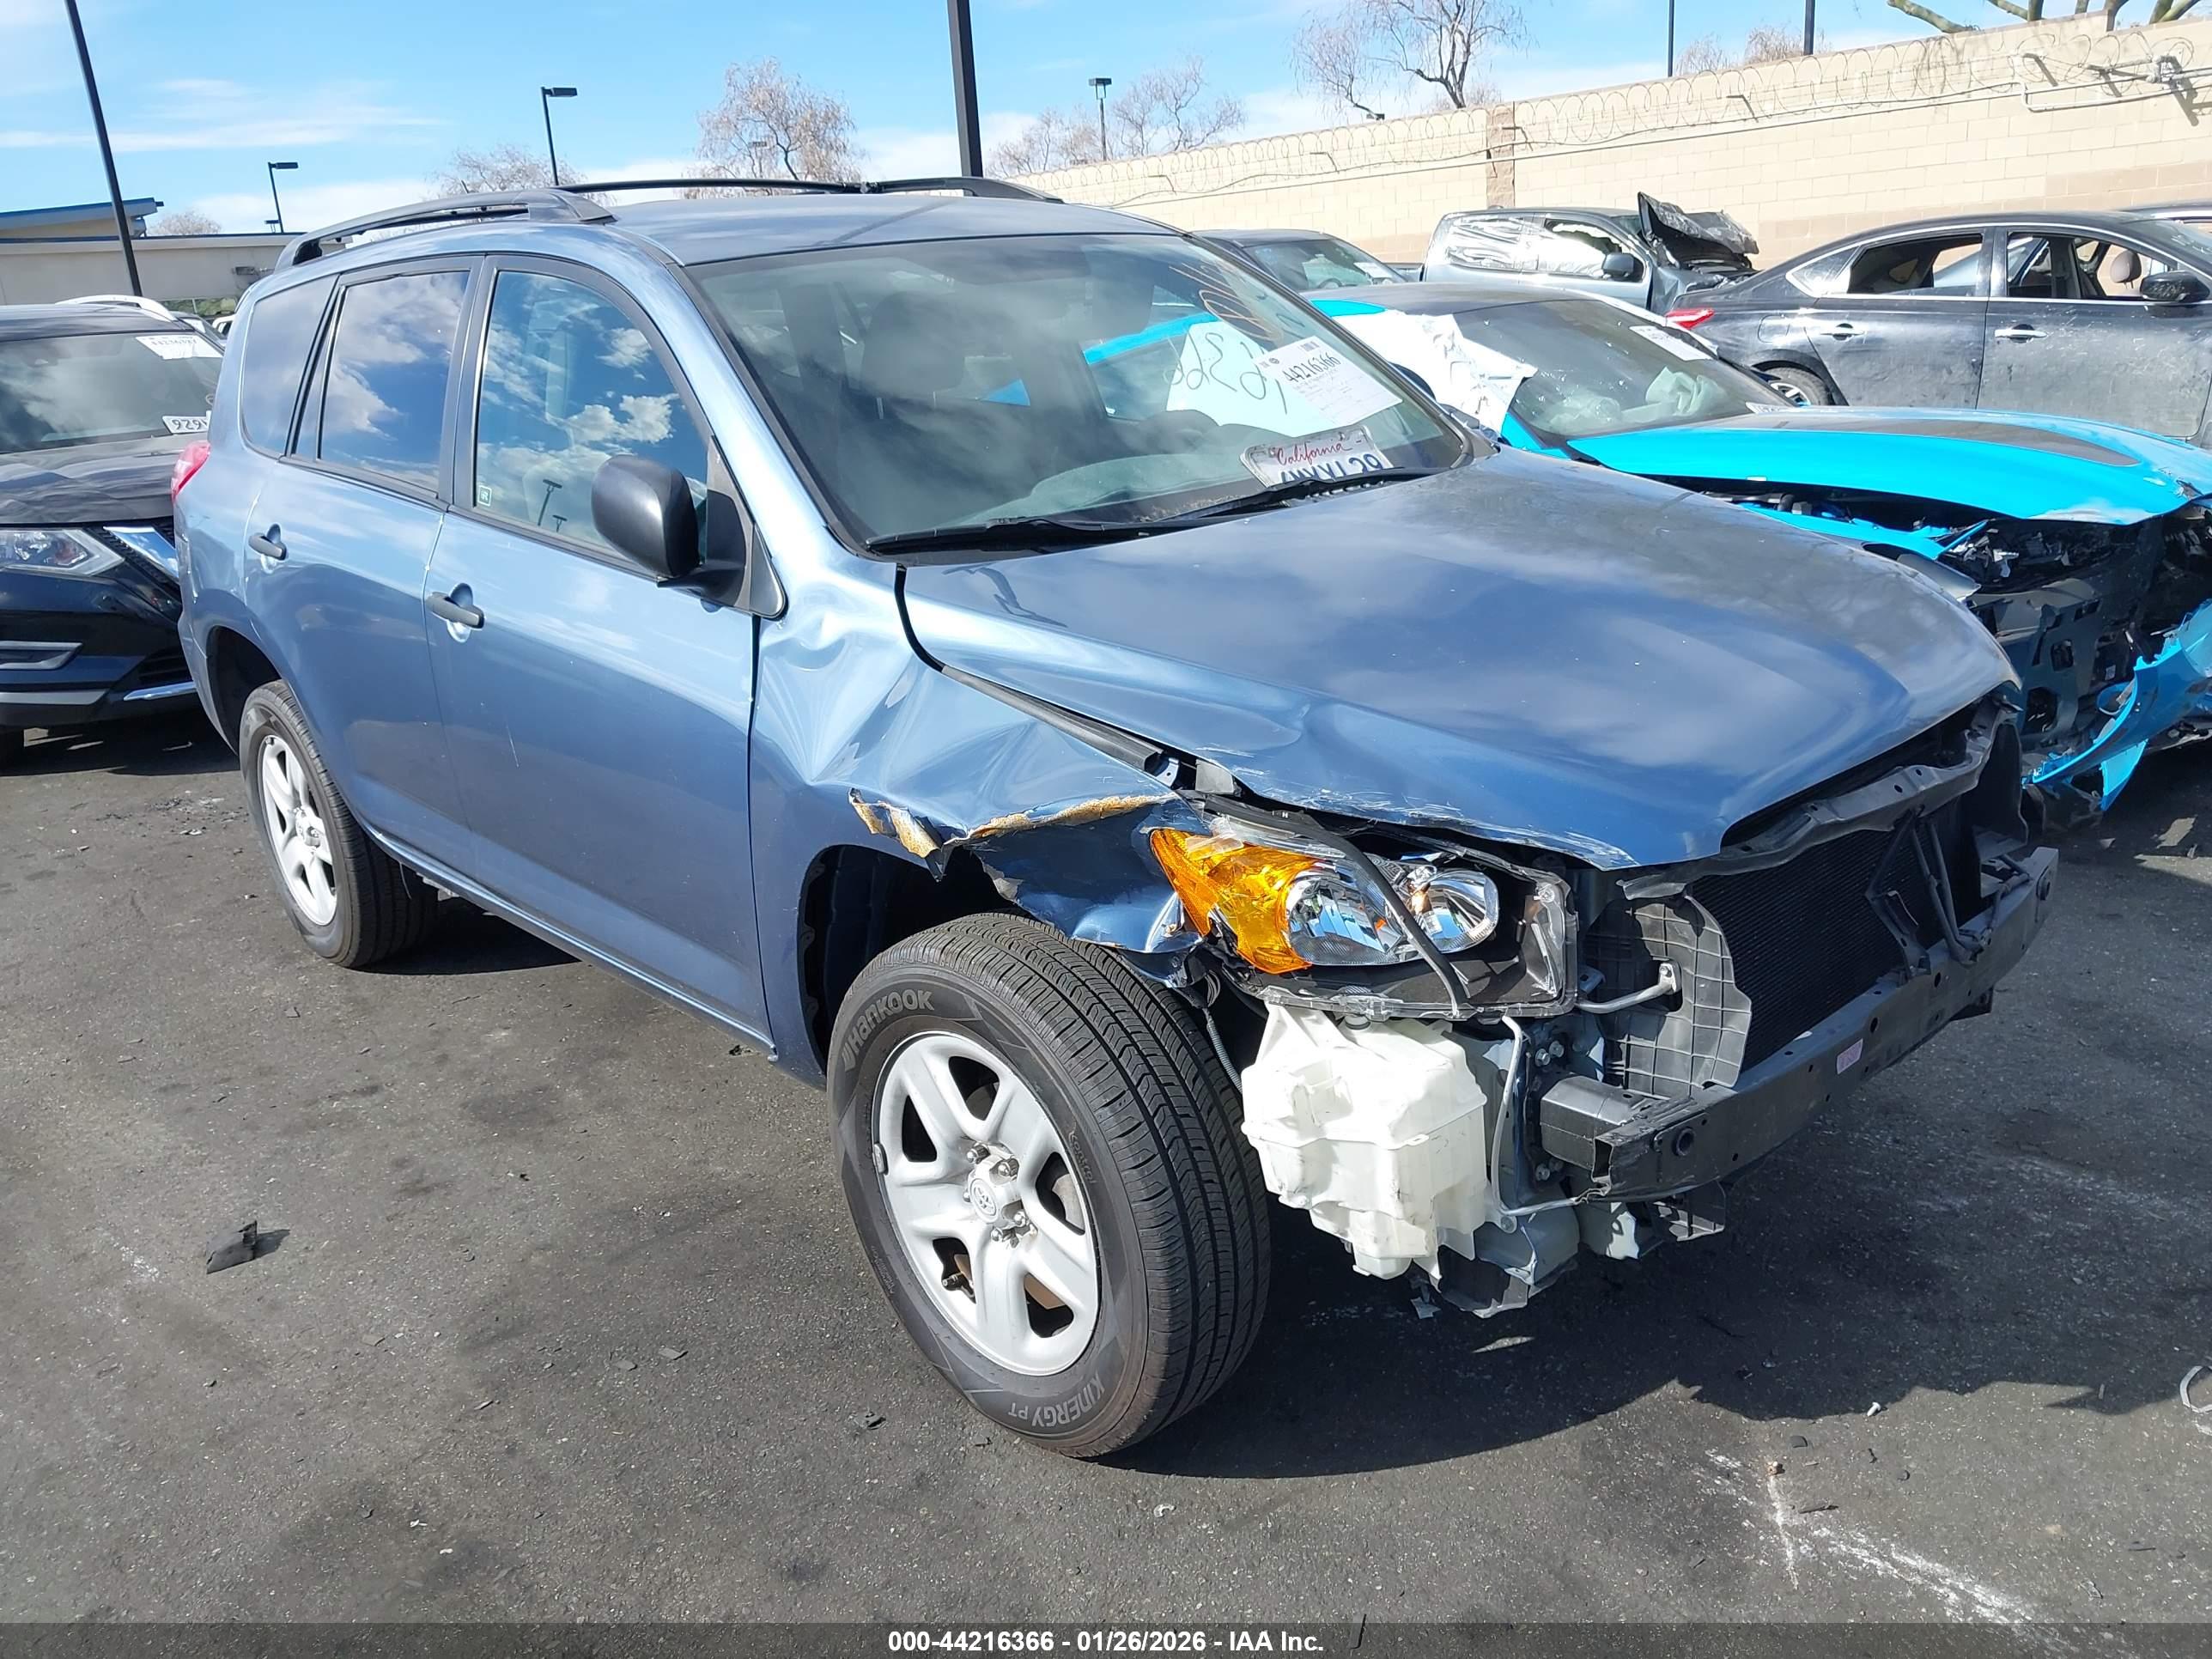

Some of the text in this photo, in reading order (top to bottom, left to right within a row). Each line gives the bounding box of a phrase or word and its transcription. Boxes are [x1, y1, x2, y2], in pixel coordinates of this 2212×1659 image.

[1282, 352, 1341, 383] 44216366
[1277, 441, 1353, 465] California
[1007, 1402, 1029, 1420] PT
